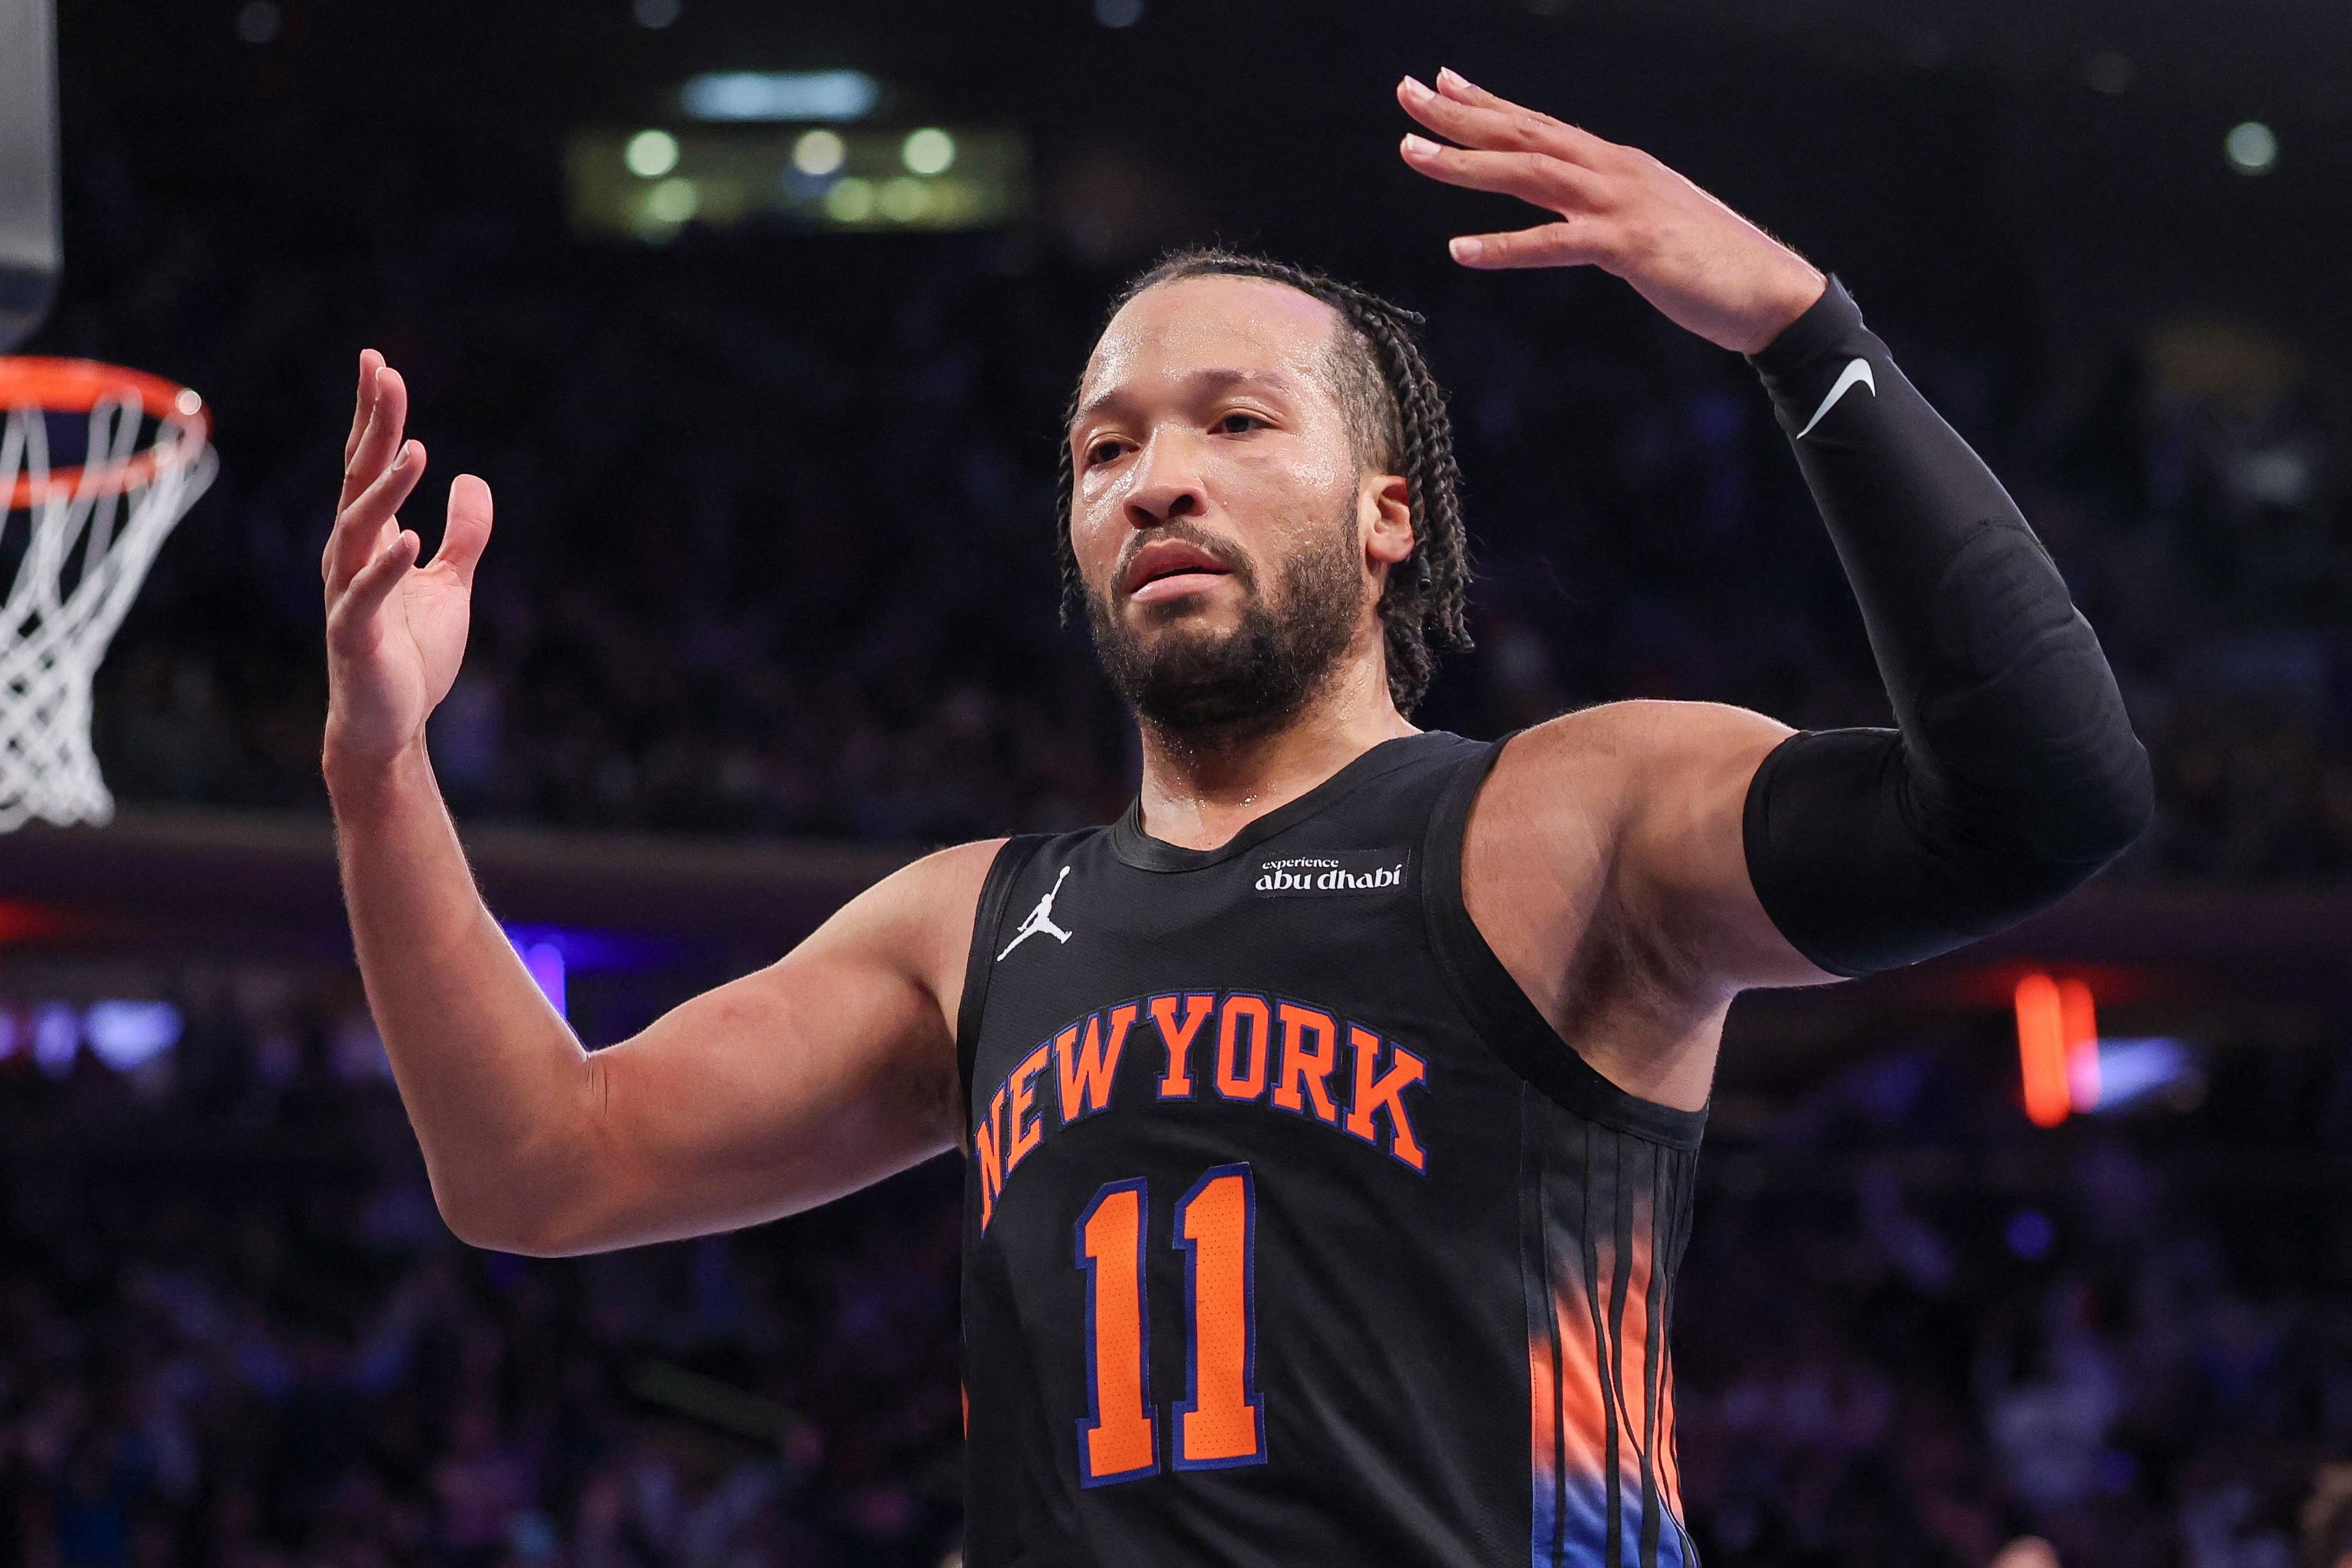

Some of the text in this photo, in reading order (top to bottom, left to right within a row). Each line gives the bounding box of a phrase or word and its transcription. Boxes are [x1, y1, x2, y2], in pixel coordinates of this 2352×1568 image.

[1255, 864, 1402, 890] abu dhabi
[1262, 857, 1339, 870] experience
[974, 992, 1427, 1239] NEW YORK
[1075, 1162, 1268, 1490] 11
